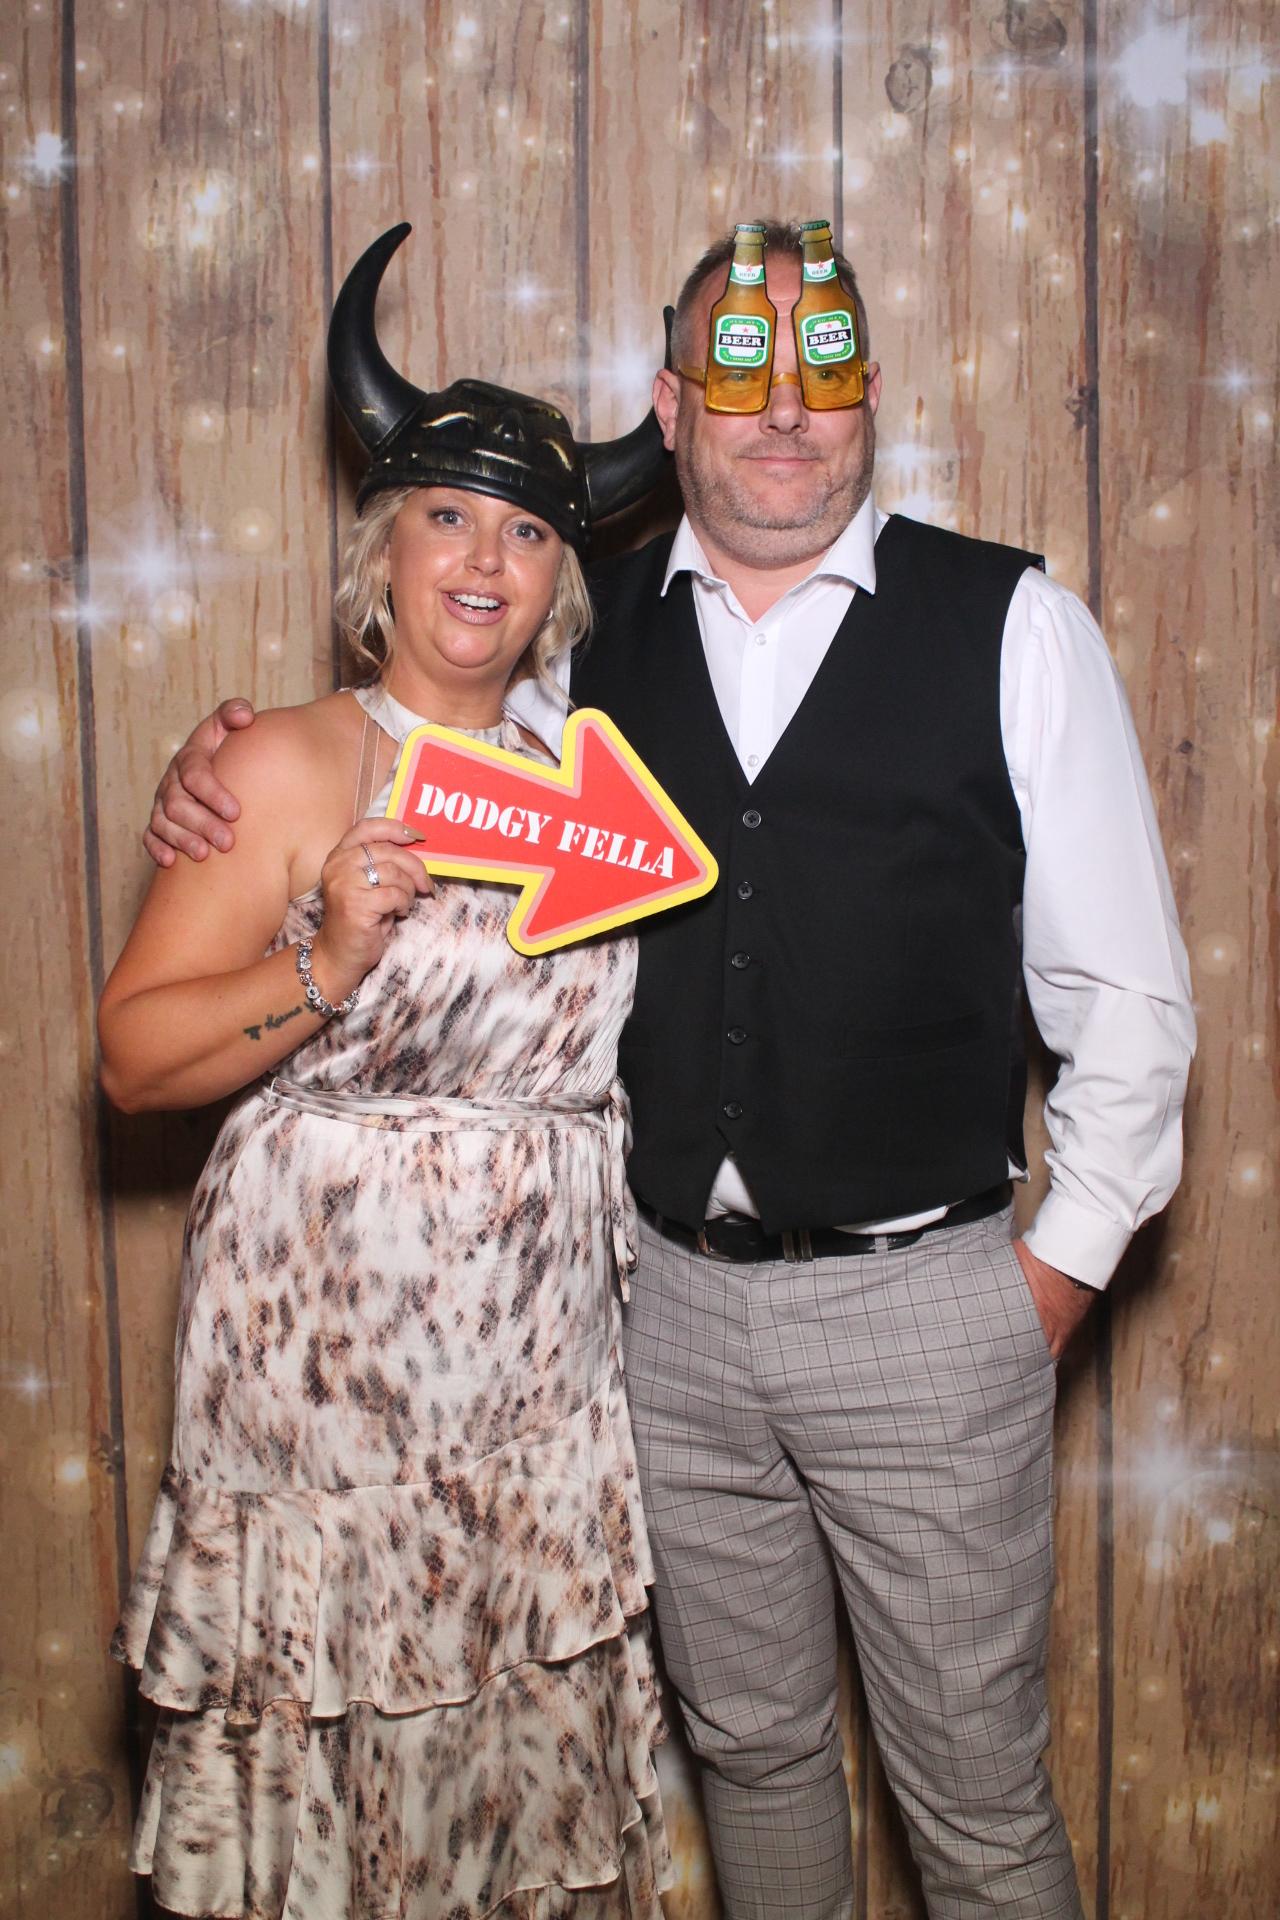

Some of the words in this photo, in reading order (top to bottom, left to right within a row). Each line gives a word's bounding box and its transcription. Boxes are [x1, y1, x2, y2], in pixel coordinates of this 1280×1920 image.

[721, 335, 762, 346] BEER
[809, 331, 849, 345] BEER
[415, 783, 552, 844] DODGY
[557, 820, 674, 879] FELLA
